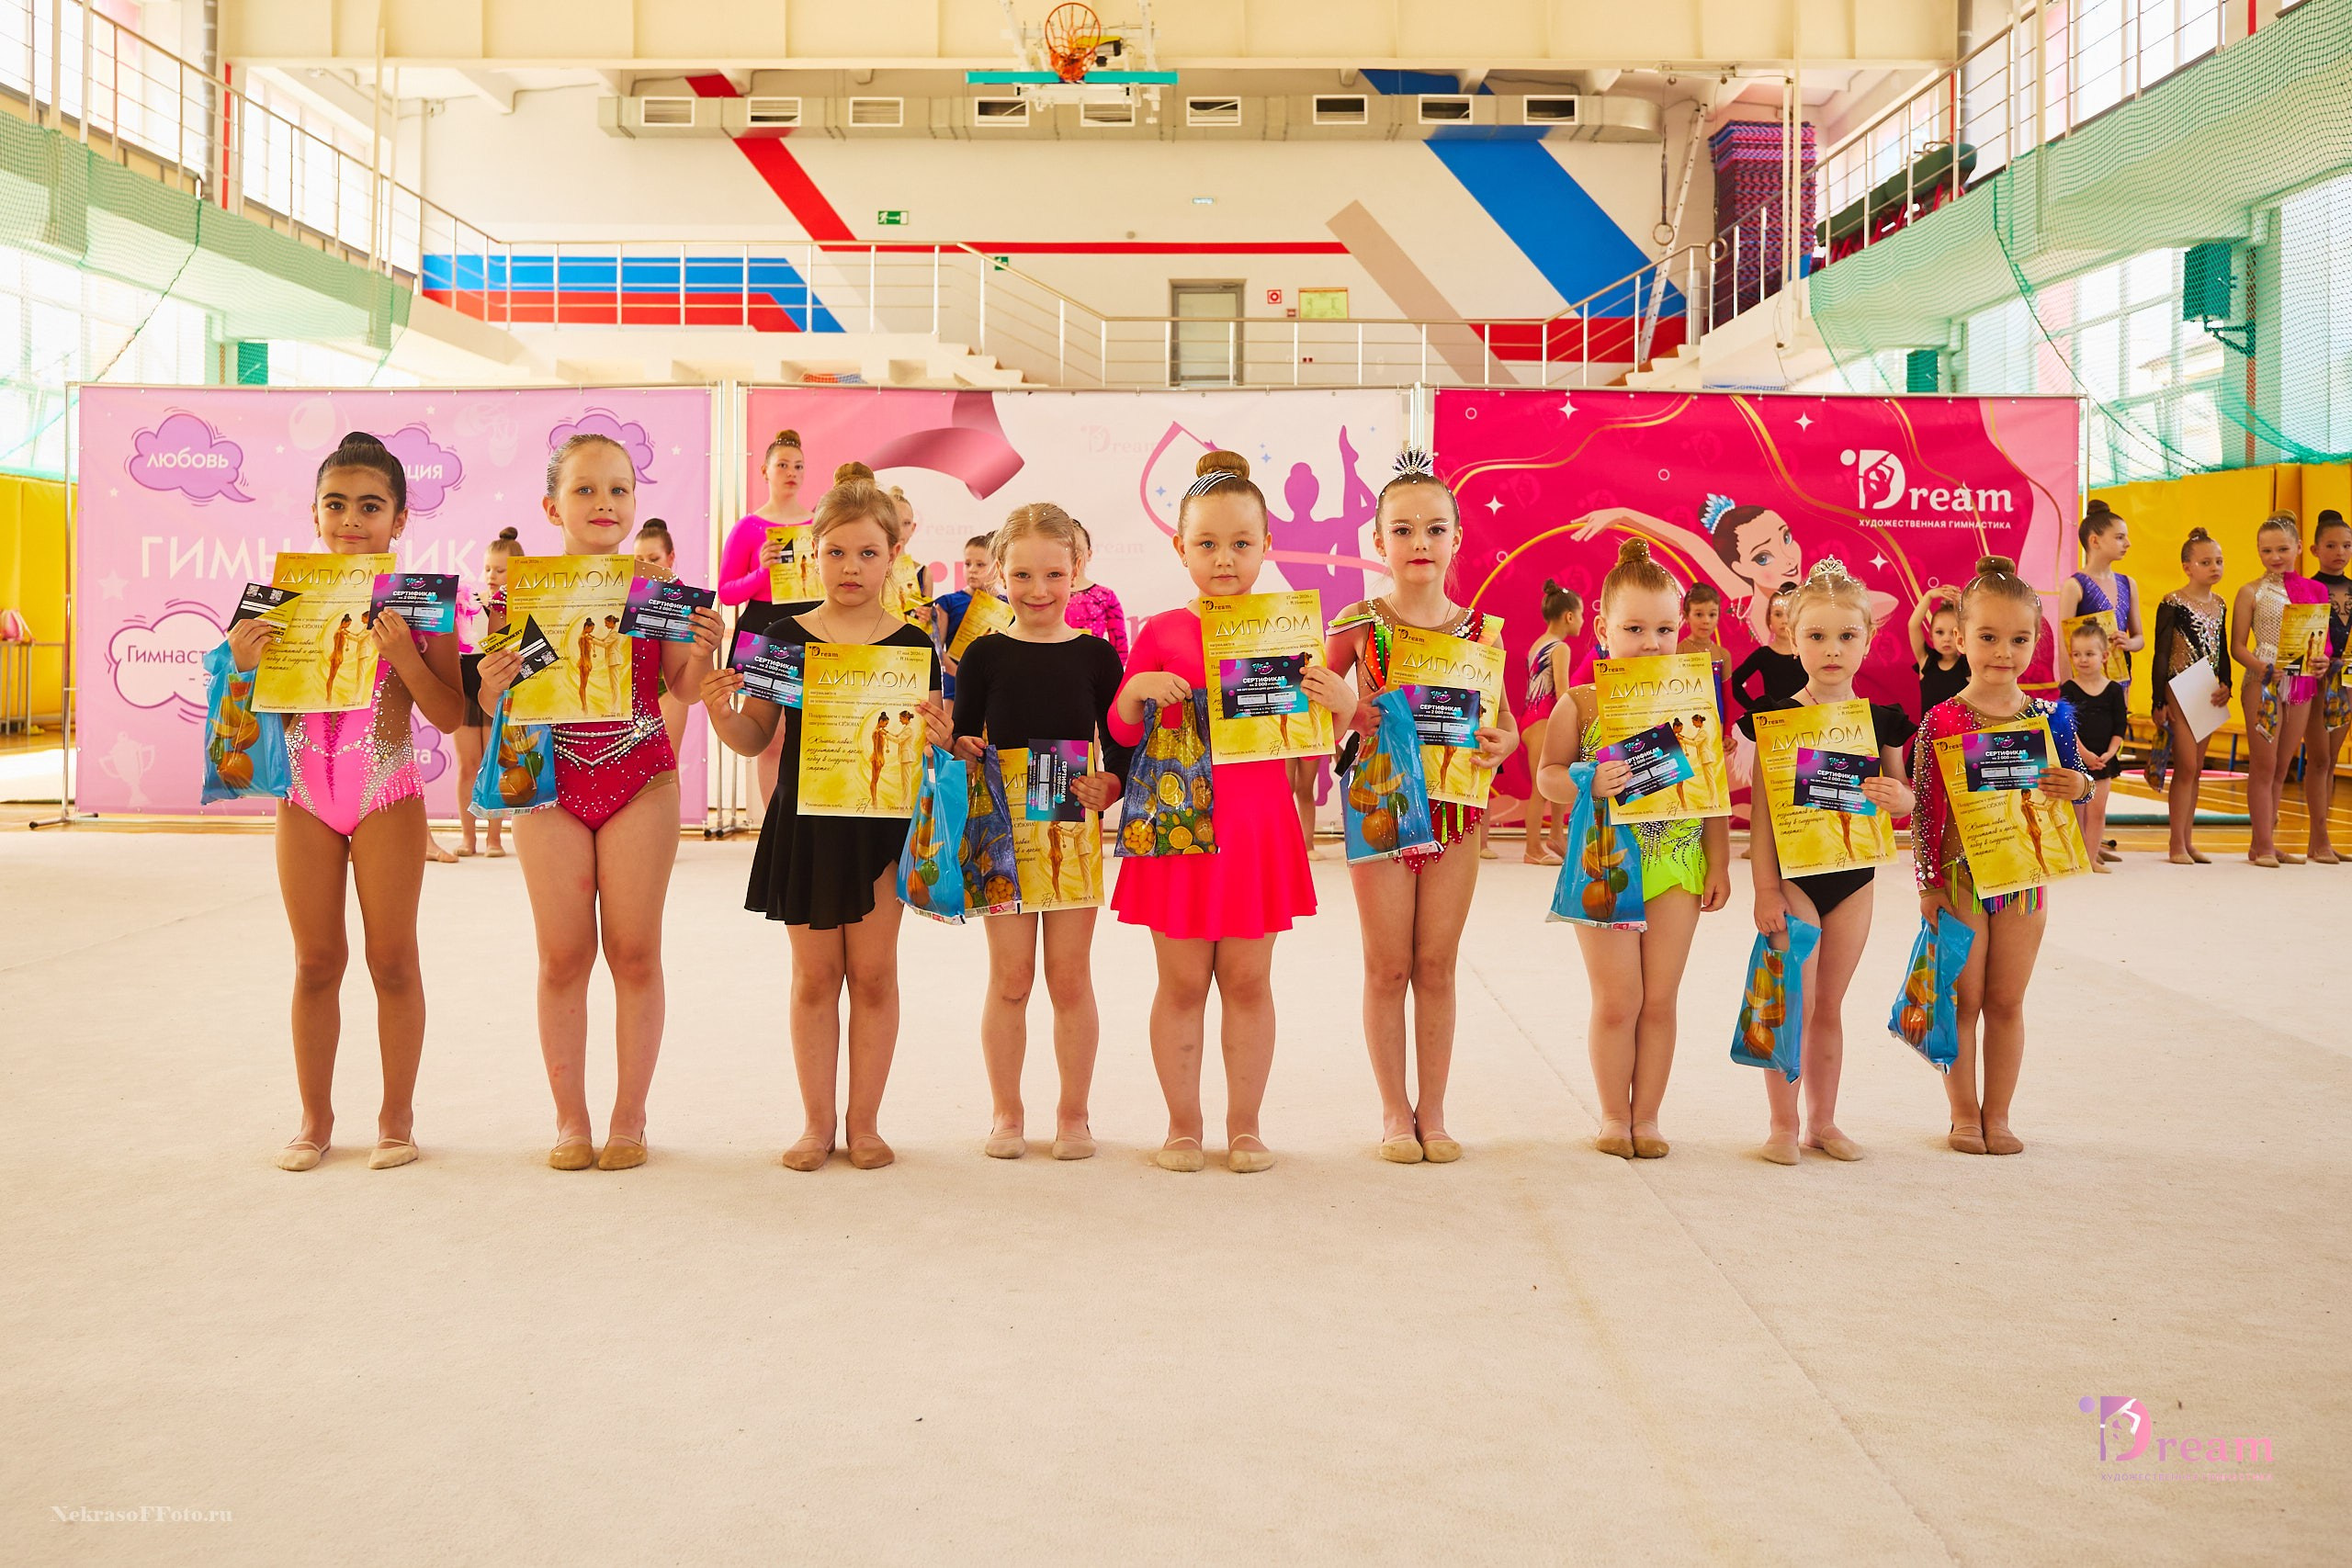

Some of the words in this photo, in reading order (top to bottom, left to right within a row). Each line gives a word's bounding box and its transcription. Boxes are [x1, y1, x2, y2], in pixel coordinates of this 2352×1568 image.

[1840, 449, 2013, 512] Dream
[1859, 519, 1947, 528] ХУДОЖЕСТВЕННАЯ
[1949, 520, 2011, 529] ГИМНАСТИКА
[514, 570, 624, 589] ДИПЛОМ
[648, 598, 691, 610] СЕРТИФИКАТ
[1203, 601, 1231, 610] Dream
[1216, 615, 1310, 637] ДИПЛОМ
[1398, 628, 1425, 642] Dream
[808, 646, 838, 658] Dream
[753, 655, 797, 671] СЕРТИФИКАТ
[1402, 652, 1491, 685] ДИПЛОМ
[1597, 663, 1625, 672] Dream
[818, 670, 917, 688] ДИПЛОМ
[1242, 675, 1284, 683] СЕРТИФИКАТ
[1611, 678, 1702, 699] ДИПЛОМ
[1756, 716, 1784, 726] Dream
[1771, 725, 1863, 751] ДИПЛОМ
[1624, 747, 1659, 763] ЕРТИФИКАТ
[1816, 769, 1858, 780] СЕРТИФИКАТ
